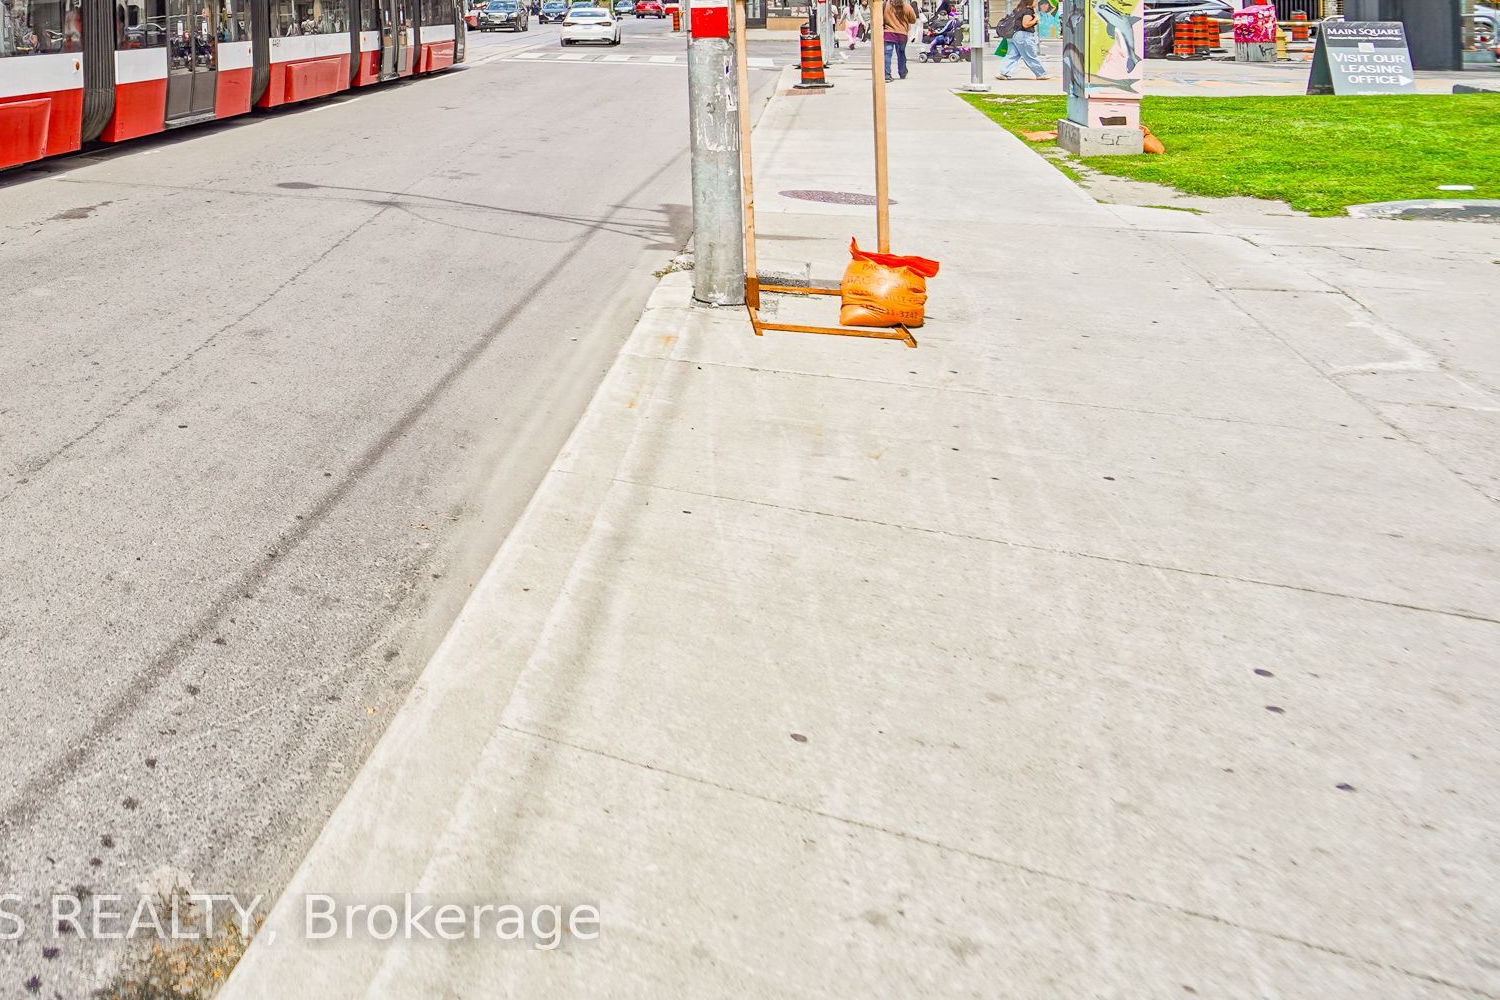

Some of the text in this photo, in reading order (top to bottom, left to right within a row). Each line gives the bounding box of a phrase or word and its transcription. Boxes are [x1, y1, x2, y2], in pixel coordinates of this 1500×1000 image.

[1359, 28, 1402, 36] SQUARE
[1332, 53, 1406, 63] VISIT OUR
[1340, 64, 1403, 73] LEASING
[1348, 75, 1399, 84] OFFICE
